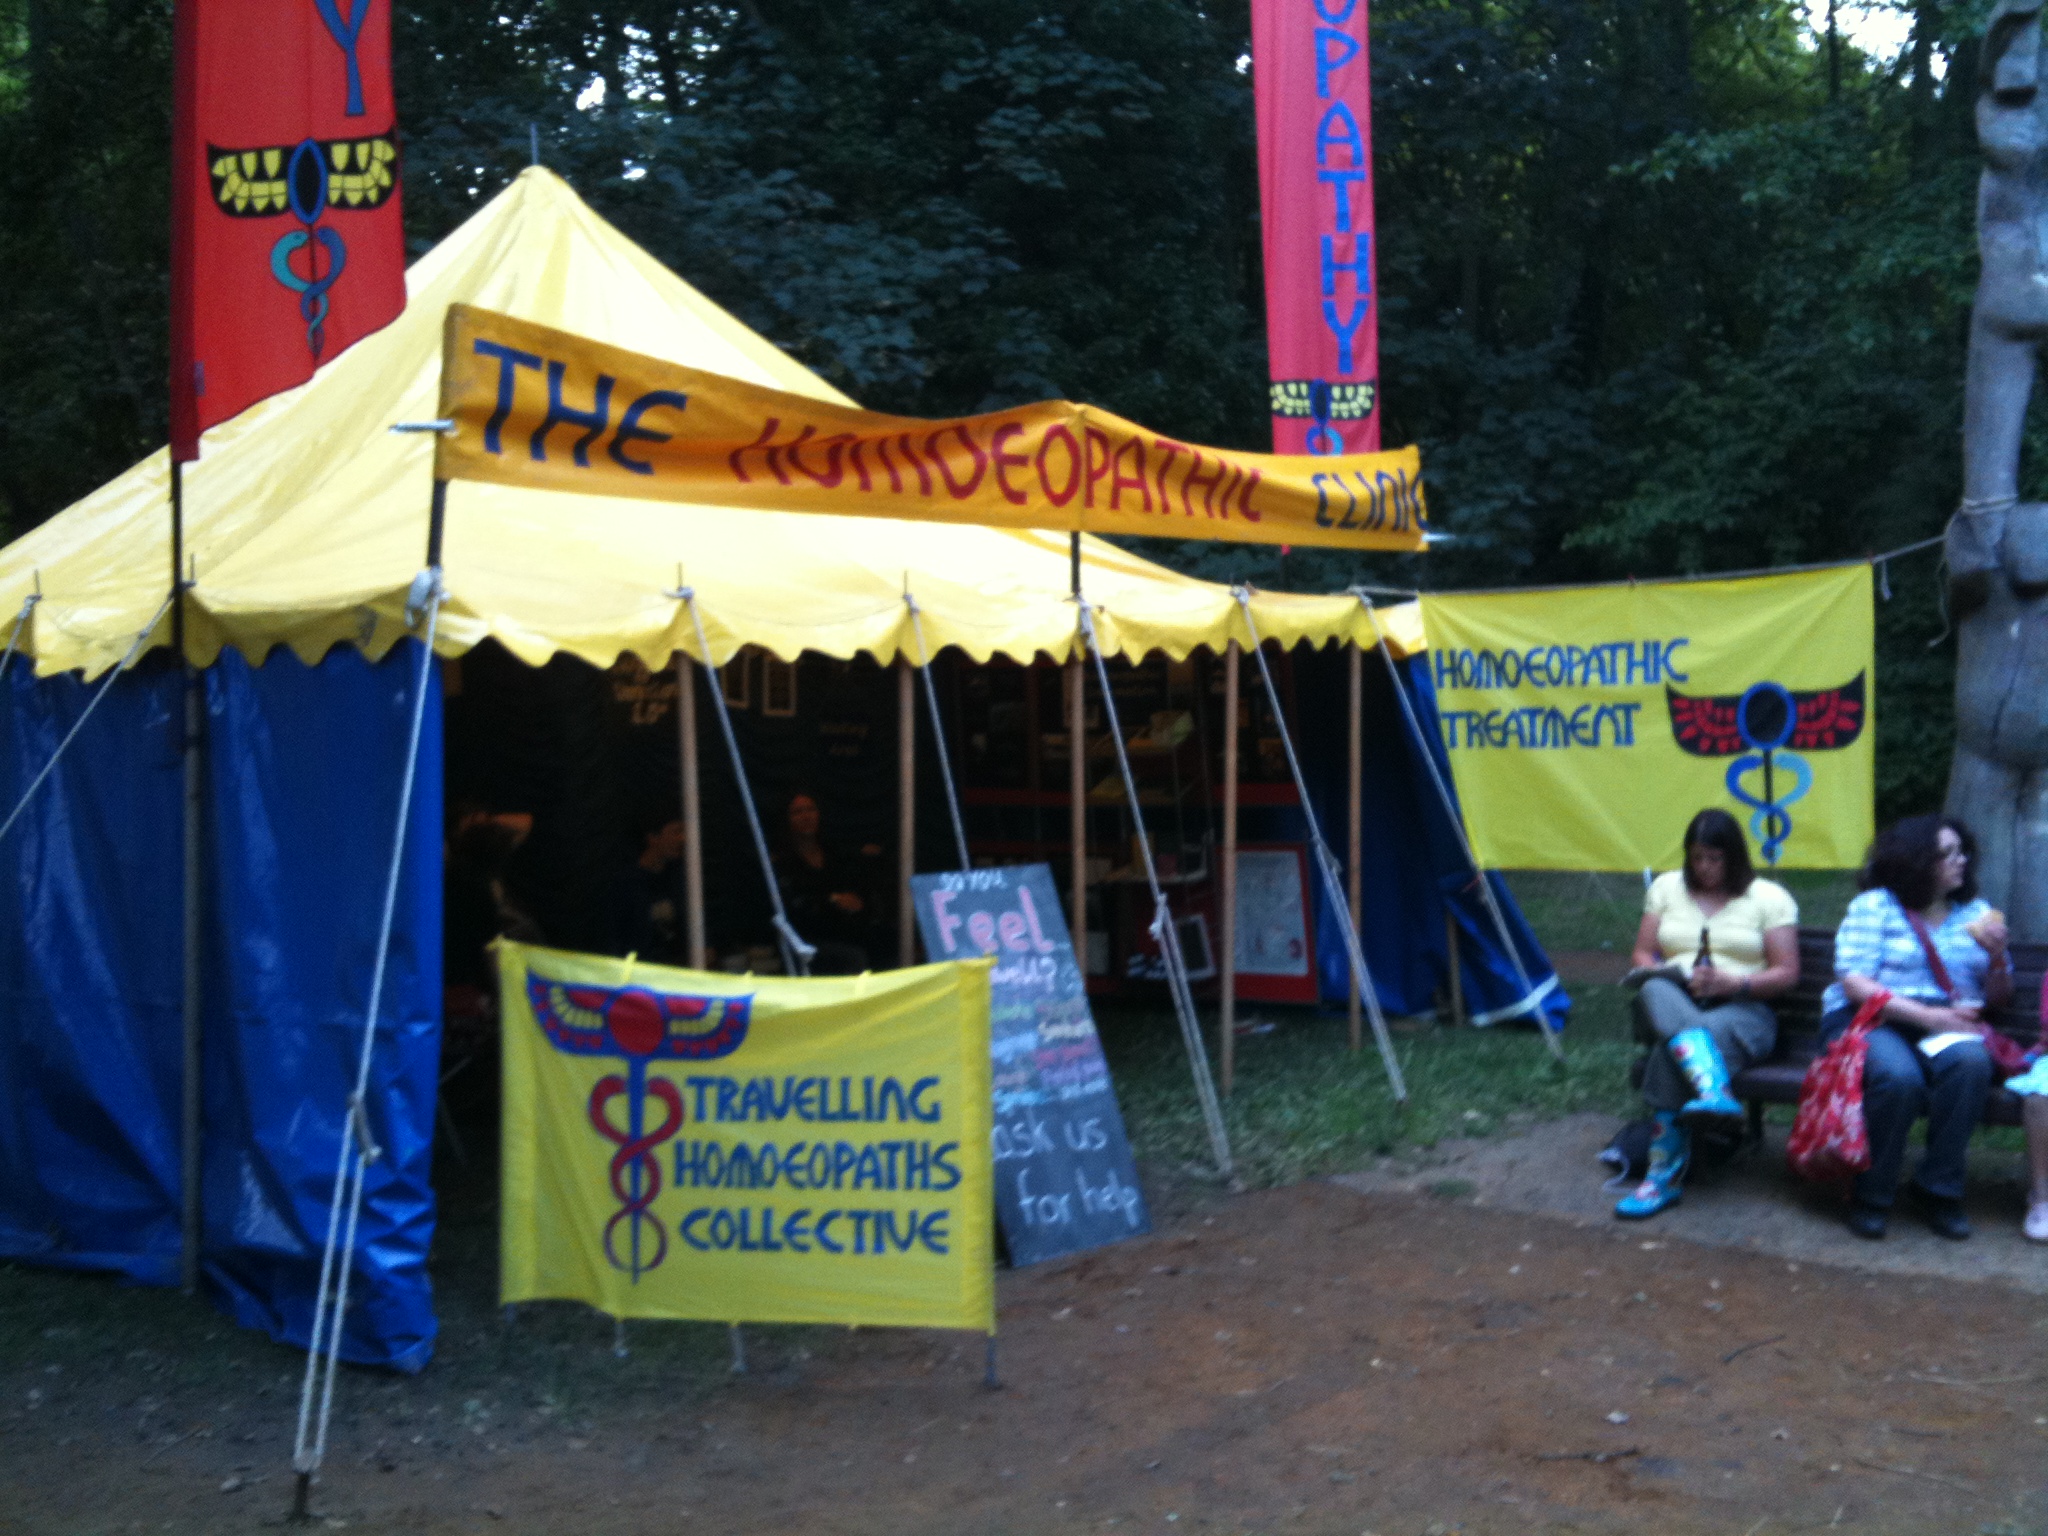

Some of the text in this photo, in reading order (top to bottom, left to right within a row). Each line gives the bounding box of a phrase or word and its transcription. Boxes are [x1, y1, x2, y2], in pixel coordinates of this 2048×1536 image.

[473, 337, 688, 476] THE
[729, 417, 1262, 523] HOMOEOPATHIC
[1435, 638, 1690, 689] HOMOEOPATHIC
[1441, 702, 1641, 750] TREATMENT
[684, 1075, 942, 1124] TRAVELLING
[1063, 1117, 1108, 1150] us
[673, 1140, 963, 1192] HOMOEOPATHS
[1016, 1167, 1140, 1229] for help
[678, 1207, 952, 1255] COLLECTIVE
